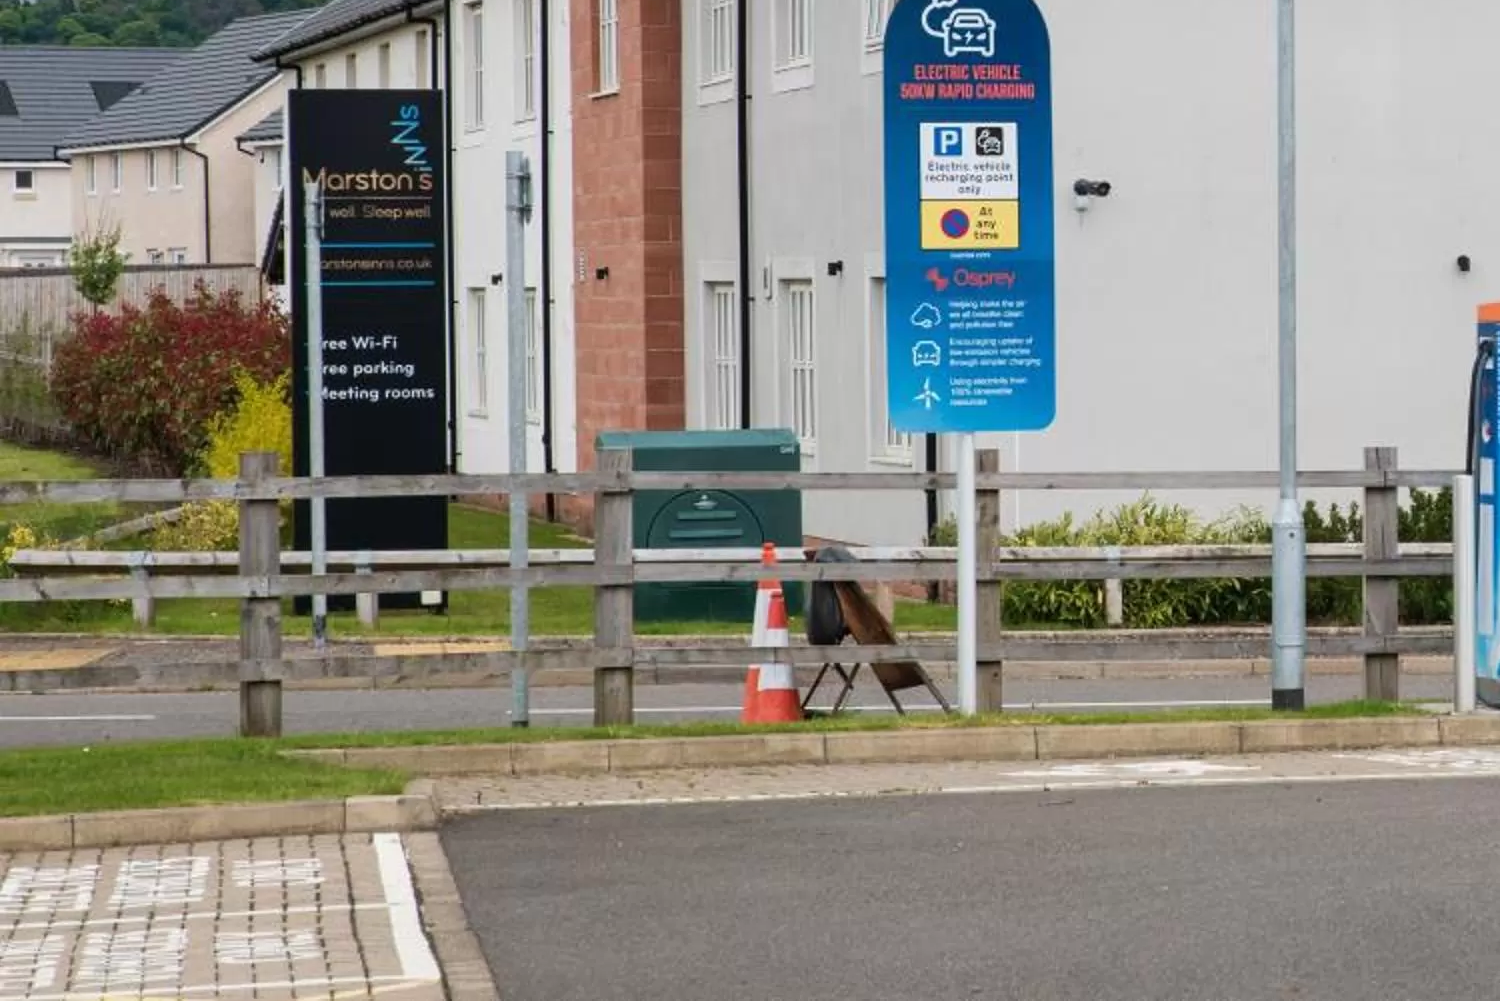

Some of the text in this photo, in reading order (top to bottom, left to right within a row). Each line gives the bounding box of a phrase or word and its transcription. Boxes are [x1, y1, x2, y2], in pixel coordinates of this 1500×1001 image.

[914, 64, 1022, 80] ELECTRIC VEHICLE
[938, 83, 973, 99] RAPID
[976, 83, 1035, 99] CHARGING
[939, 130, 959, 154] P
[927, 161, 1011, 172] Electric vehicle
[924, 172, 1014, 184] recharging point
[957, 185, 982, 196] only
[363, 204, 401, 220] Sleep
[979, 206, 994, 216] At
[975, 219, 997, 230] any
[973, 230, 1000, 240] time
[954, 267, 1016, 289] Osprey
[320, 335, 398, 350] ree Wi-Fi
[320, 360, 415, 378] ree parking
[384, 387, 435, 399] rooms
